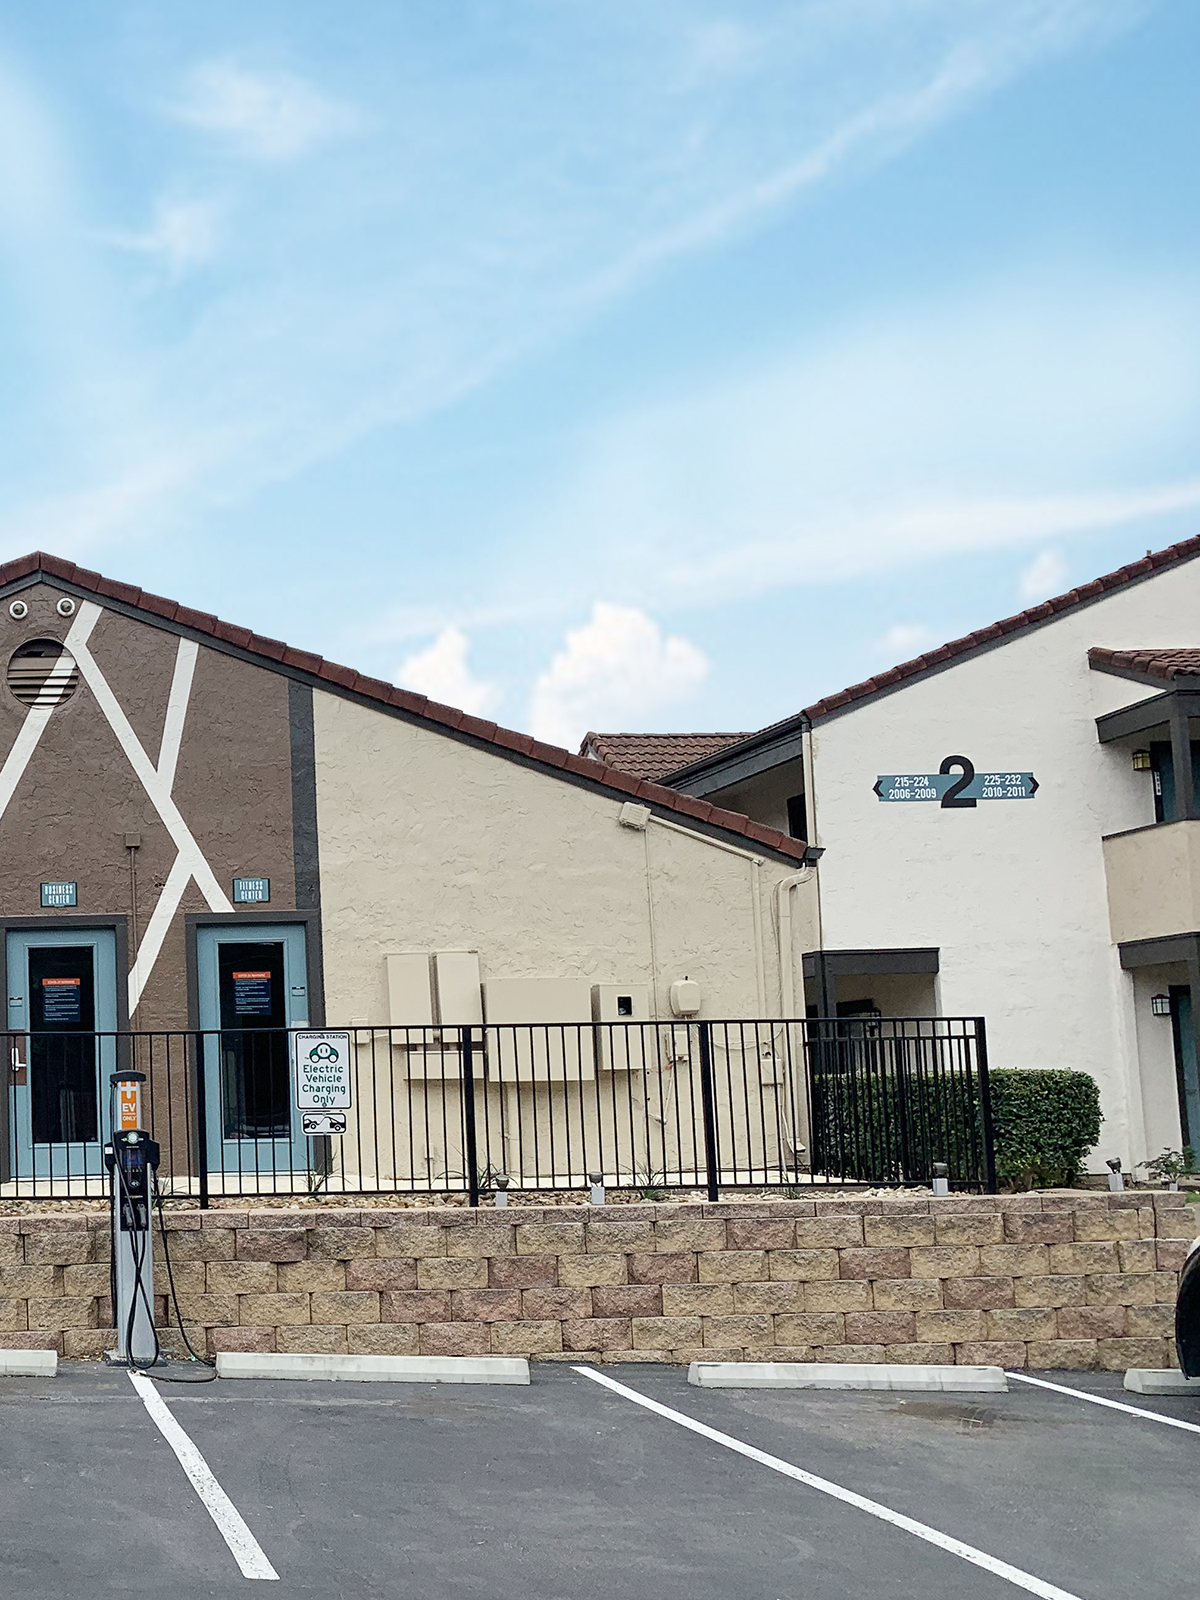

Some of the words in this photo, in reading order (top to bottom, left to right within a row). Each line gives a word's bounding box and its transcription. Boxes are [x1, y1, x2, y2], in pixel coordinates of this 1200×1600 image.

[894, 776, 929, 787] 215-224
[939, 755, 977, 808] 2
[984, 775, 1022, 785] 225-232
[888, 788, 937, 799] 2006-2009
[982, 787, 1026, 797] 2010-2011
[44, 885, 73, 895] BUSINESS
[239, 881, 263, 890] FITNESS
[48, 894, 70, 904] CENTER
[241, 890, 262, 900] CENTER
[303, 1064, 343, 1073] Electric
[305, 1074, 342, 1082] Vehicle
[302, 1084, 346, 1095] Charging
[312, 1095, 335, 1105] Only
[122, 1103, 136, 1112] EV
